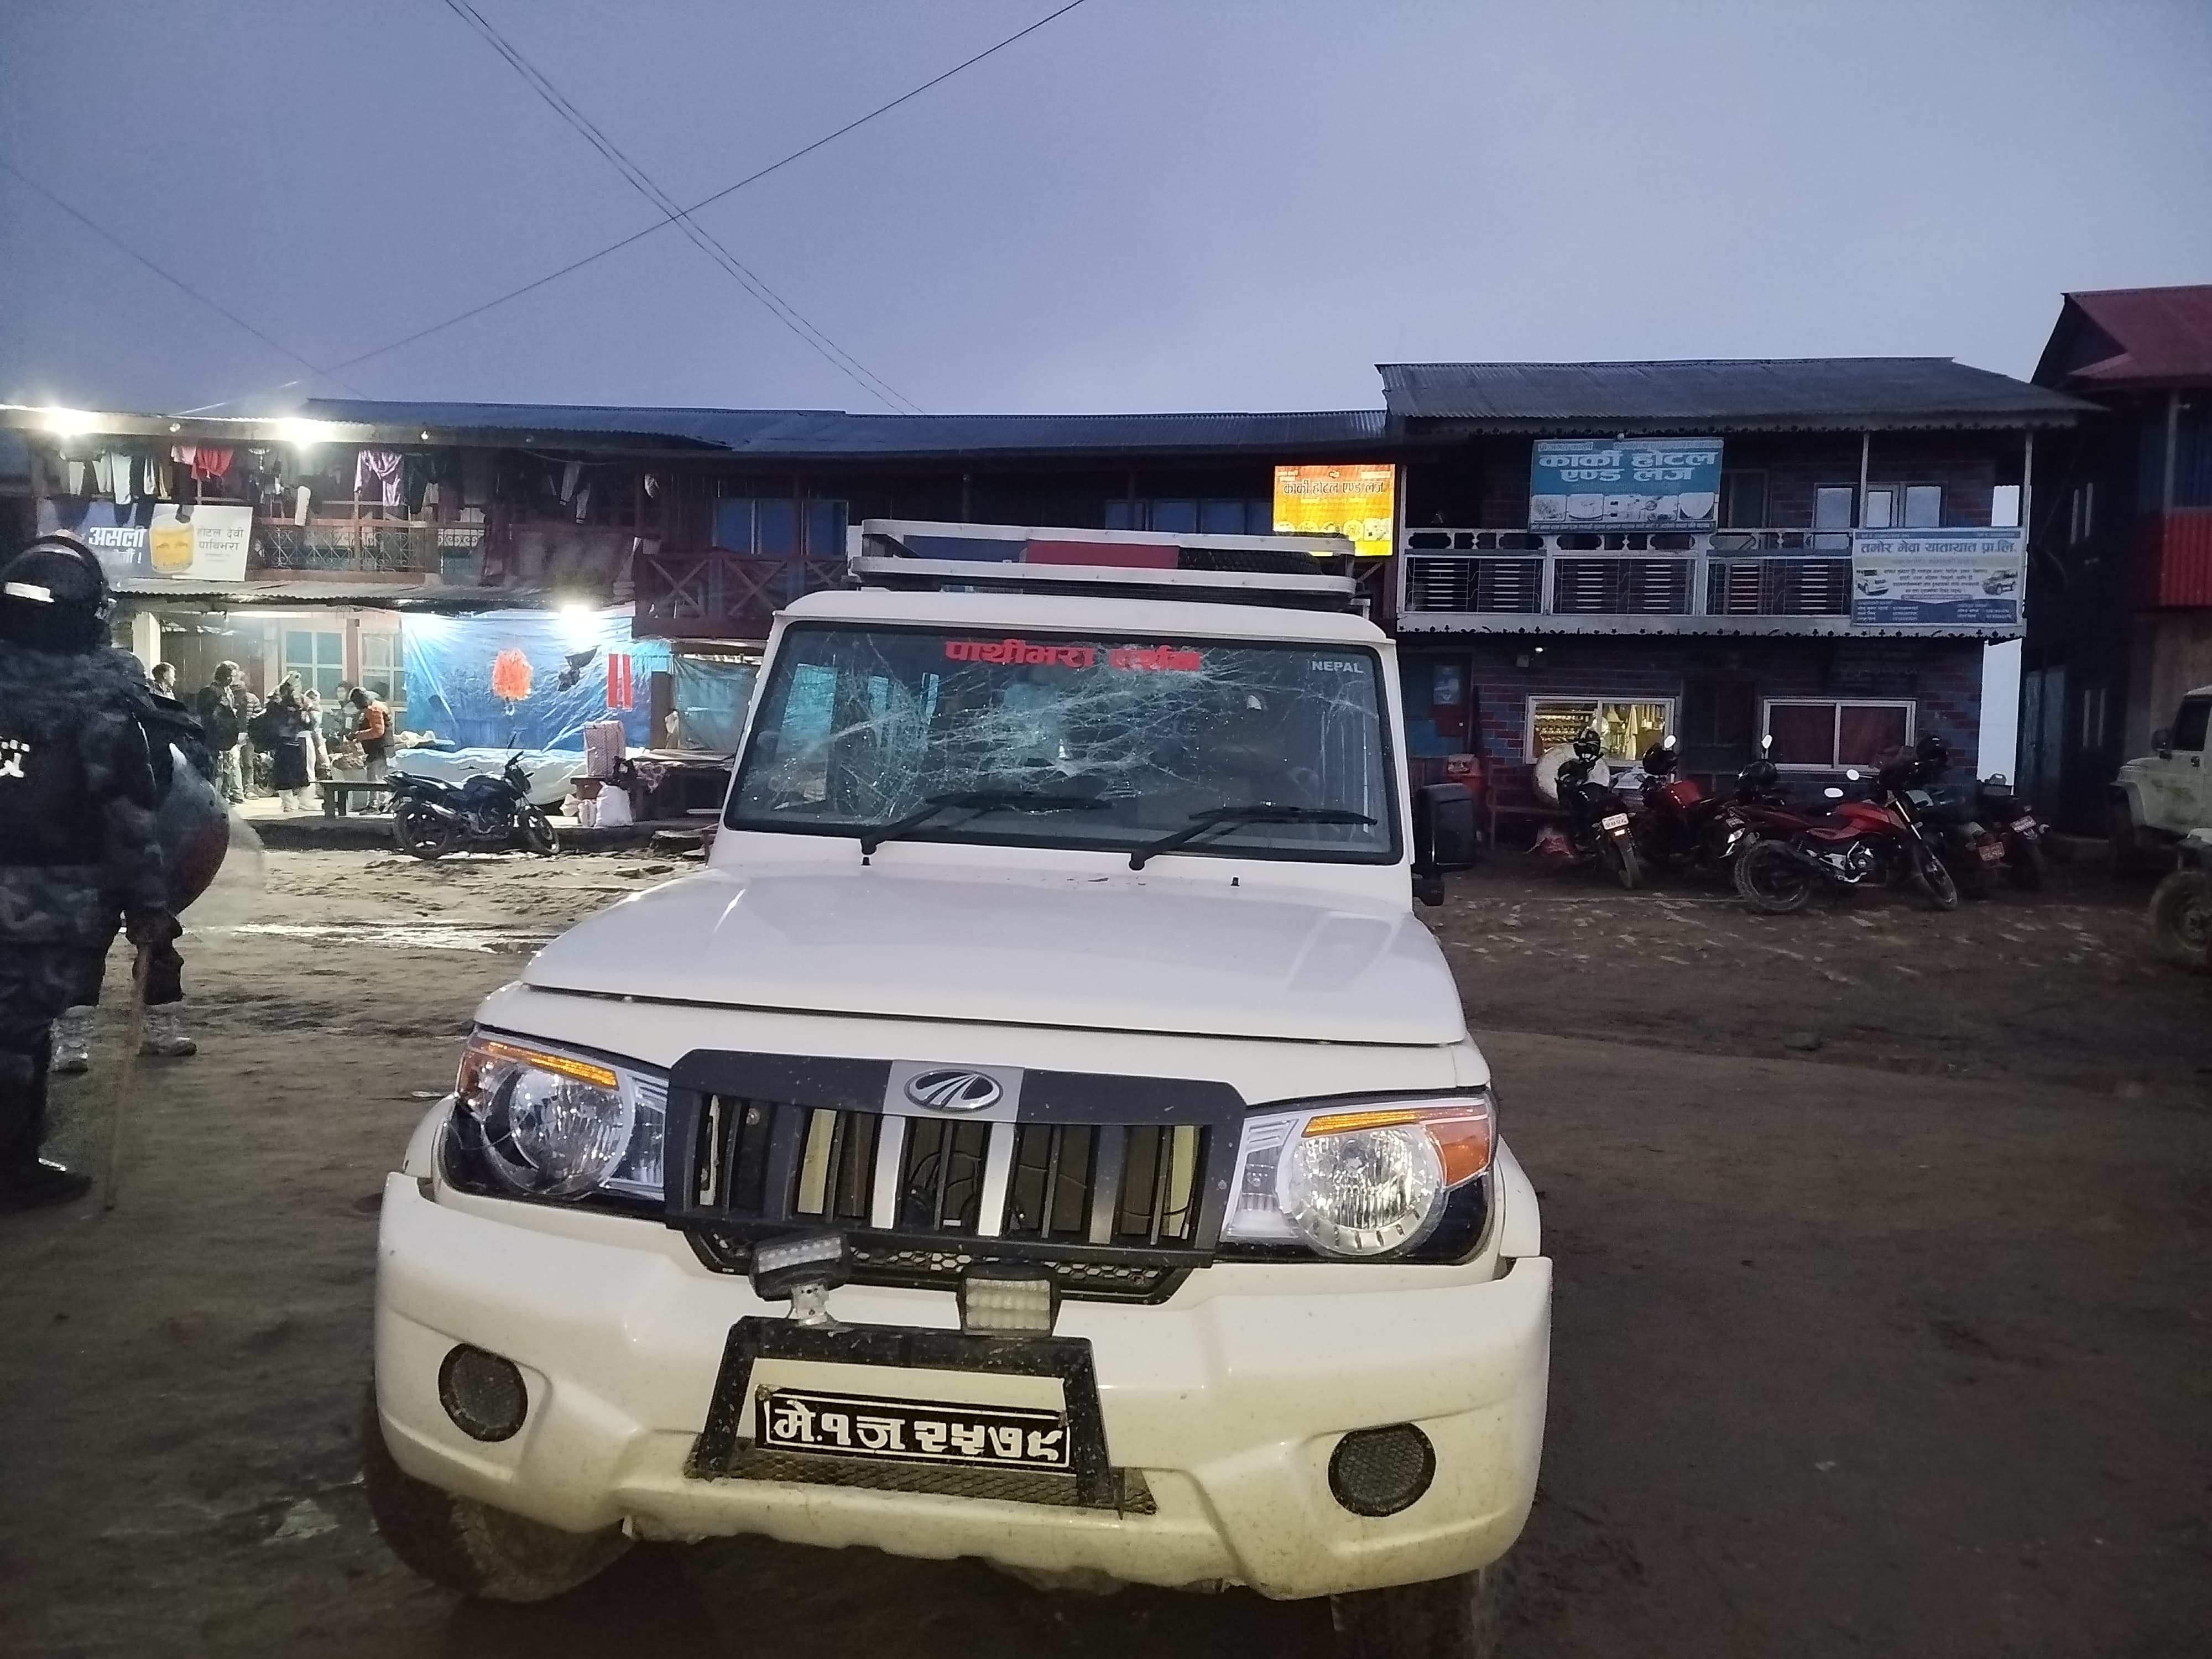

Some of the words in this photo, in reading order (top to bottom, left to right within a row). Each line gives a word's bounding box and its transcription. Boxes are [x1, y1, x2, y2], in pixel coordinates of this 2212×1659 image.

[1631, 449, 1719, 467] होटल
[1560, 468, 1625, 482] एण्ड
[1633, 467, 1695, 482] लज
[1312, 479, 1339, 494] होटल
[1342, 482, 1361, 493] एण्ड
[1365, 482, 1384, 493] लज
[88, 526, 147, 547] असली
[197, 526, 222, 537] होटल
[227, 526, 244, 539] देवी
[1860, 540, 1893, 554] तमोर
[1312, 661, 1363, 674] NEPAL
